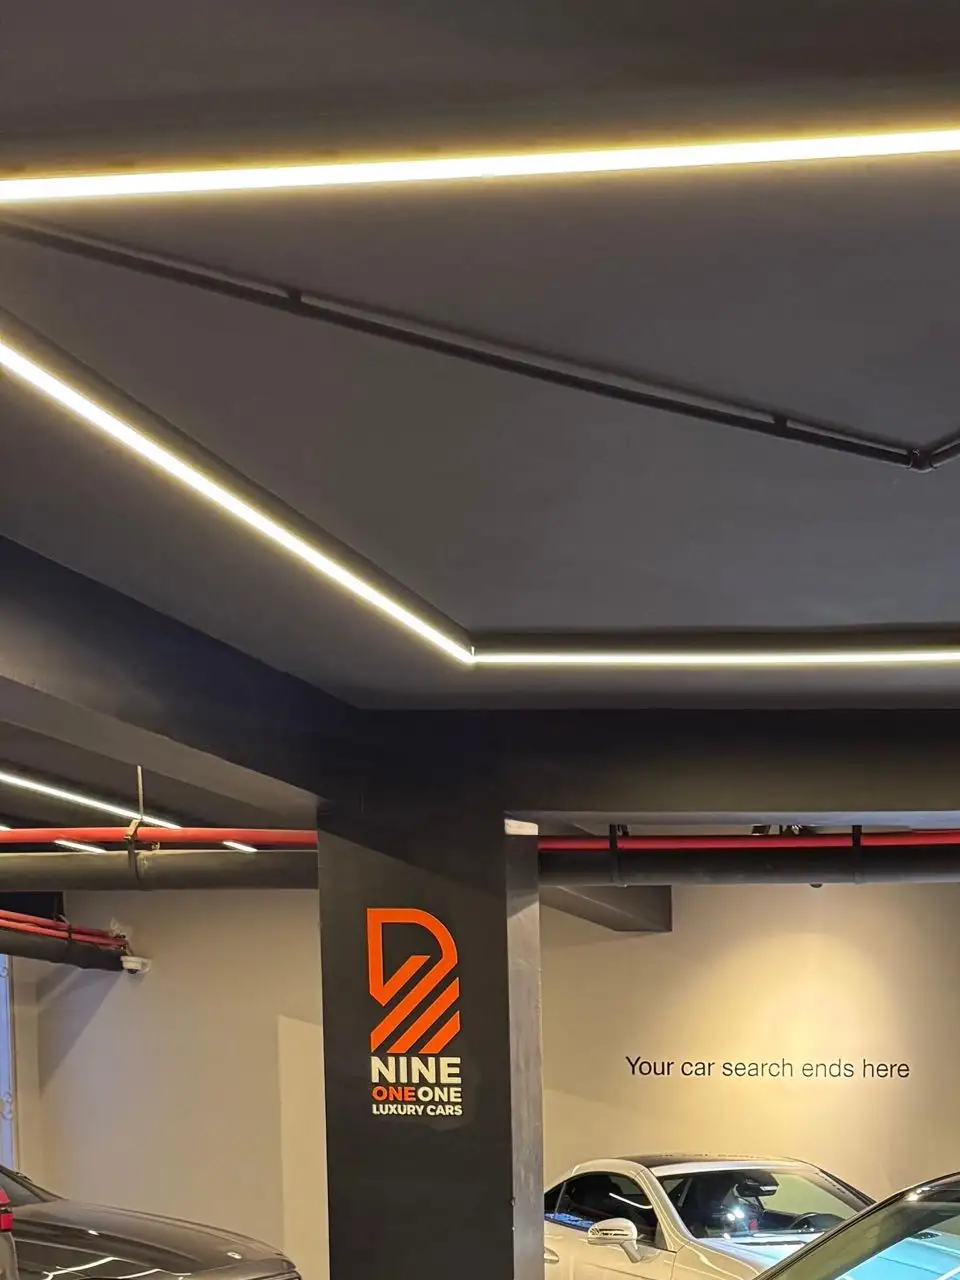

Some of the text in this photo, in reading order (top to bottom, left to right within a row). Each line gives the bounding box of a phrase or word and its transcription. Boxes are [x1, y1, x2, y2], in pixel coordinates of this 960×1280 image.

[371, 1056, 462, 1084] NINE
[625, 1056, 910, 1078] Your car search ends here
[372, 1103, 463, 1116] LUXURY CARS
